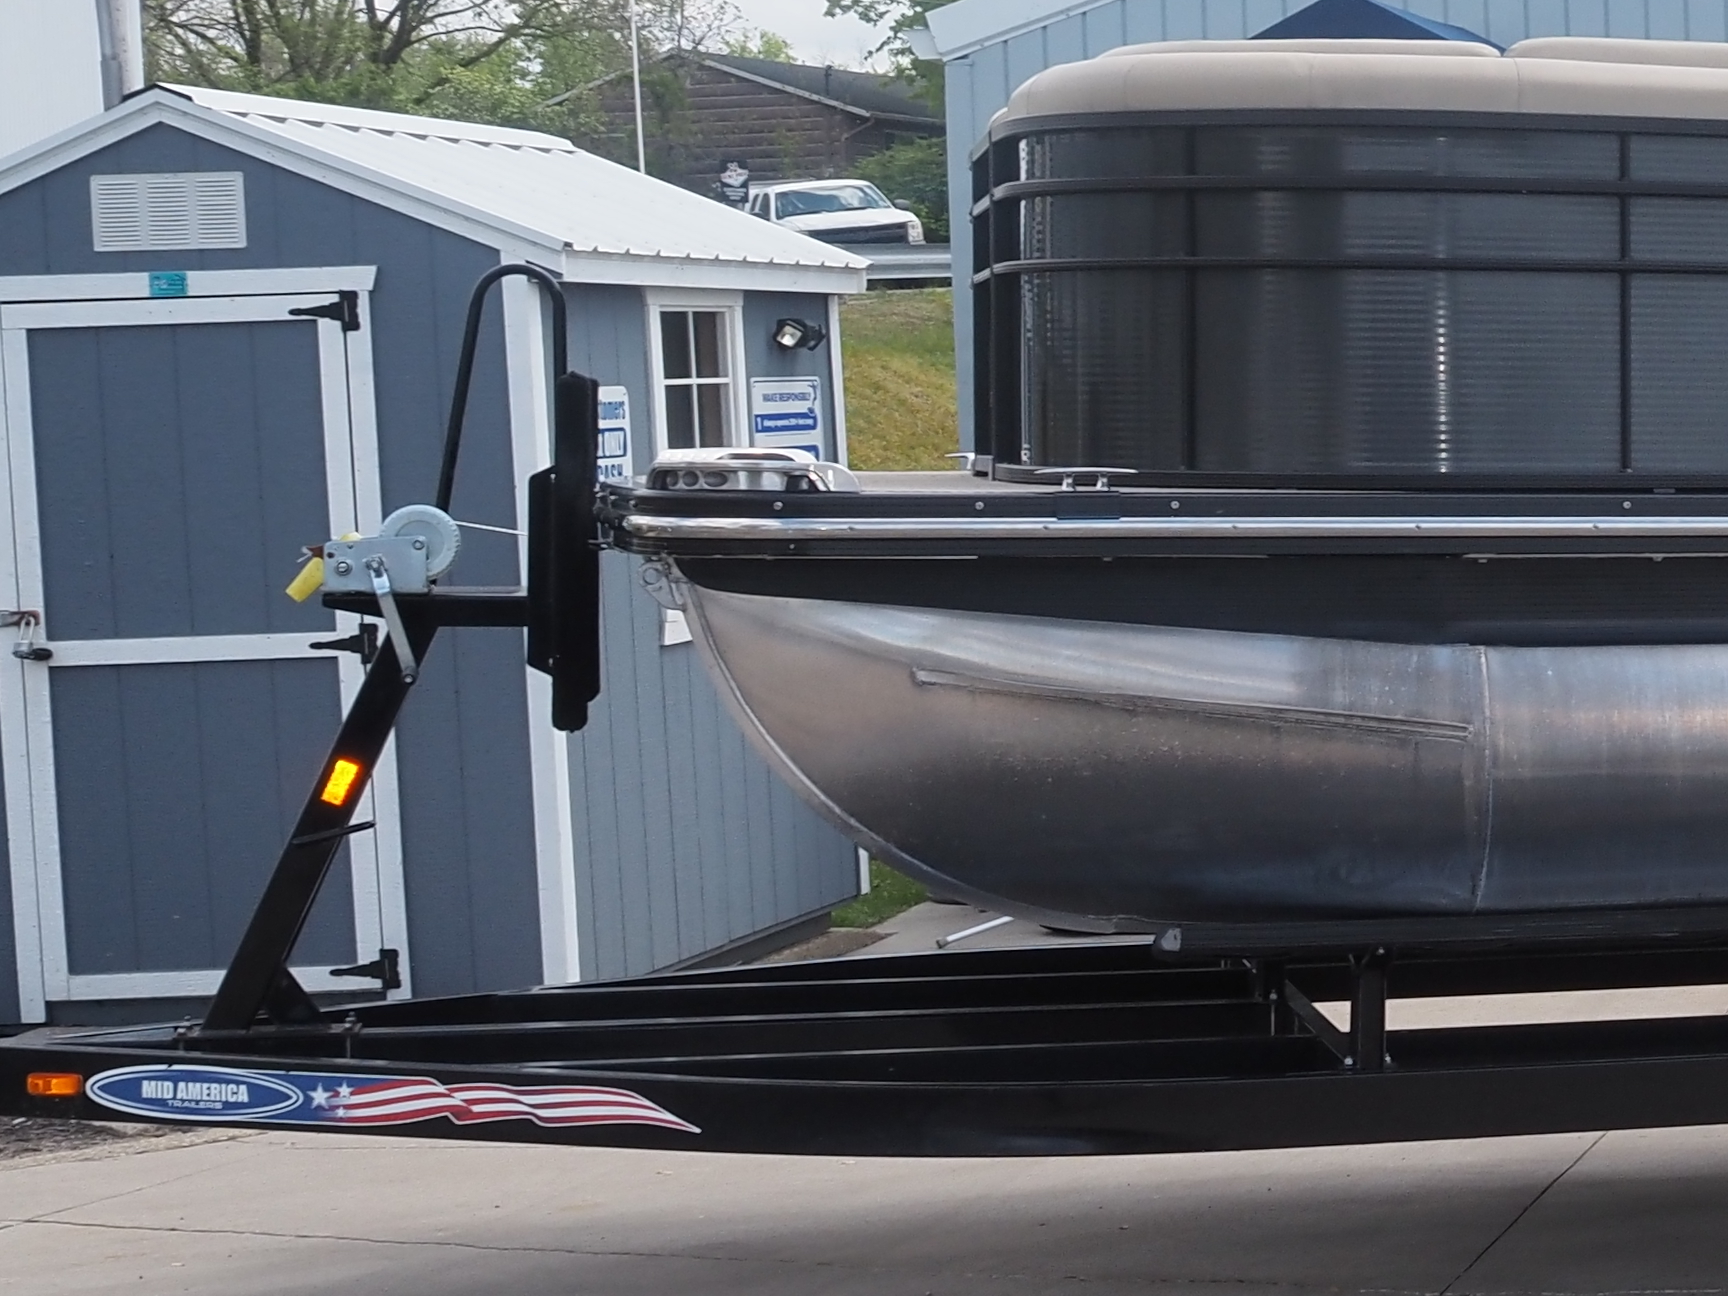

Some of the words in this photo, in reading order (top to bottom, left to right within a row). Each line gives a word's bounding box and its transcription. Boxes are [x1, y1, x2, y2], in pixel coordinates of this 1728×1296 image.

[141, 1080, 174, 1099] MID
[175, 1082, 249, 1103] AMERICA
[165, 1099, 223, 1110] TRAILERS
